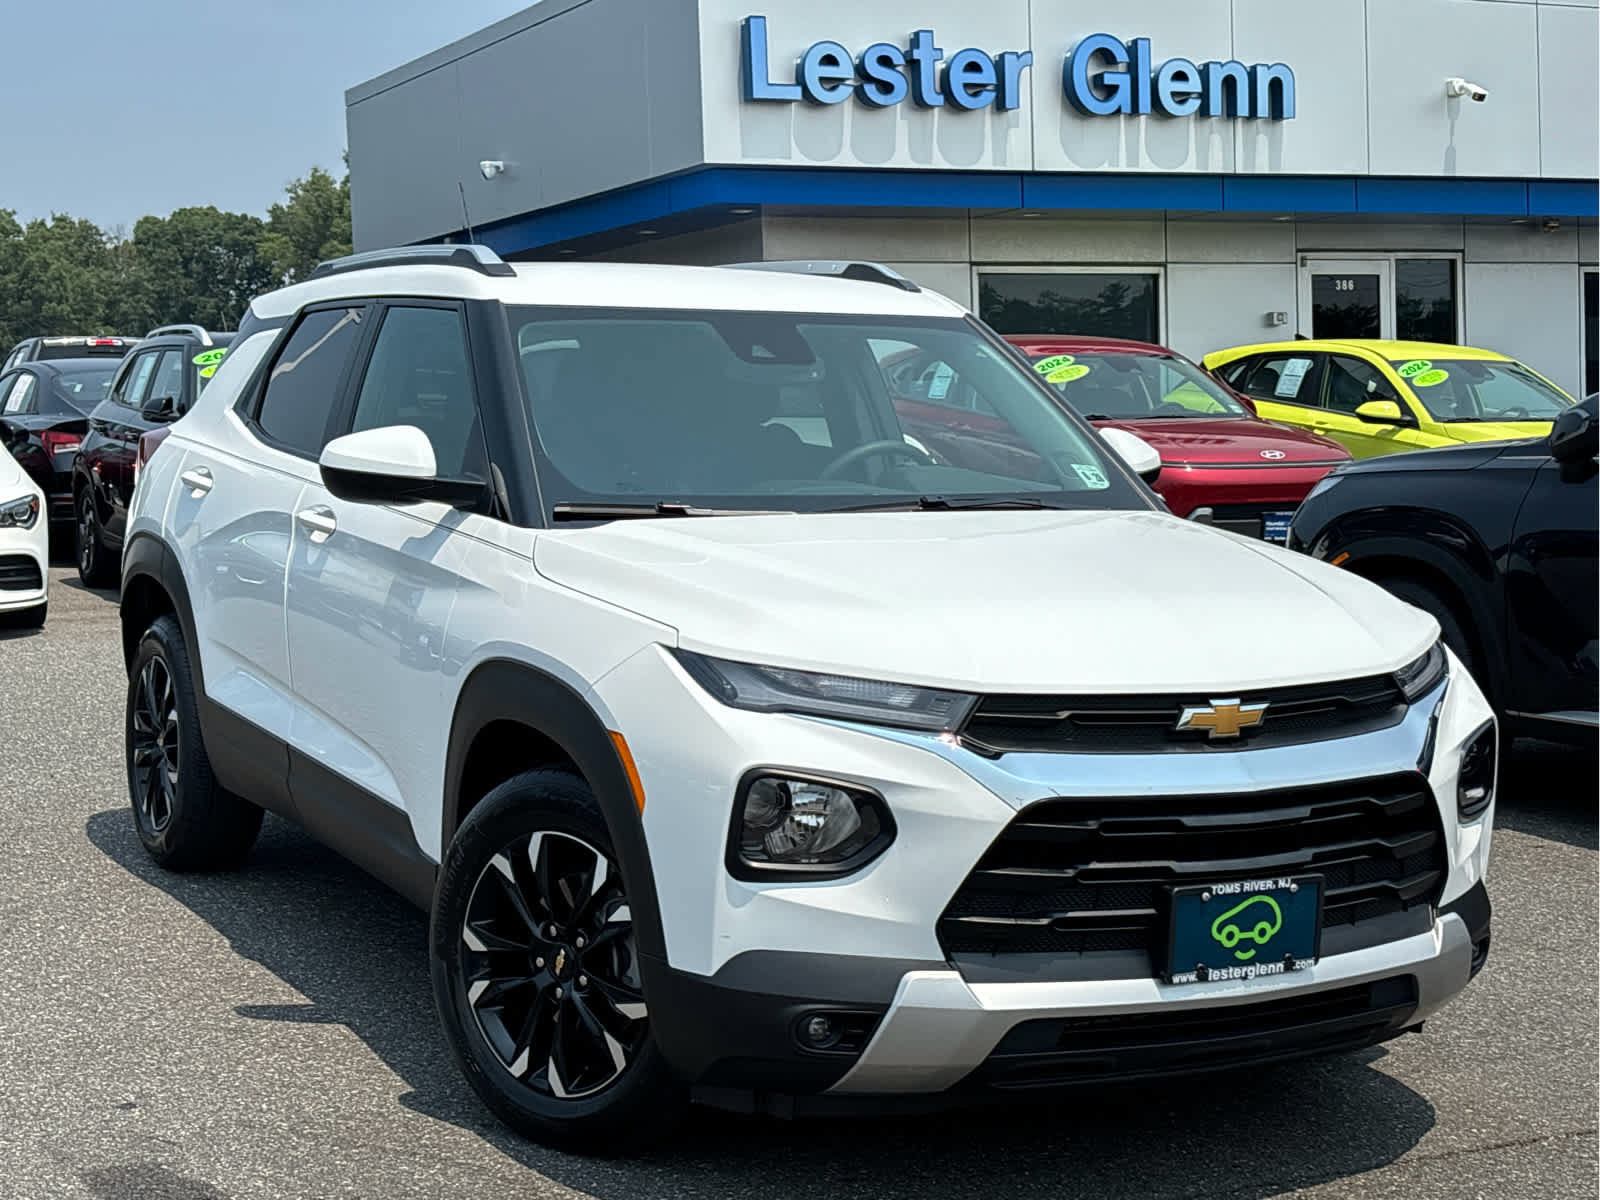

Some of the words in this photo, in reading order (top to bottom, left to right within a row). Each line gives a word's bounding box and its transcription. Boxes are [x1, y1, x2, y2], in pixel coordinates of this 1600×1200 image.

[741, 15, 1033, 111] Lester
[1064, 33, 1296, 121] Glenn
[1335, 280, 1354, 291] 386
[1037, 356, 1071, 372] 2024
[1401, 361, 1430, 376] 2024
[1211, 883, 1241, 896] TOMS
